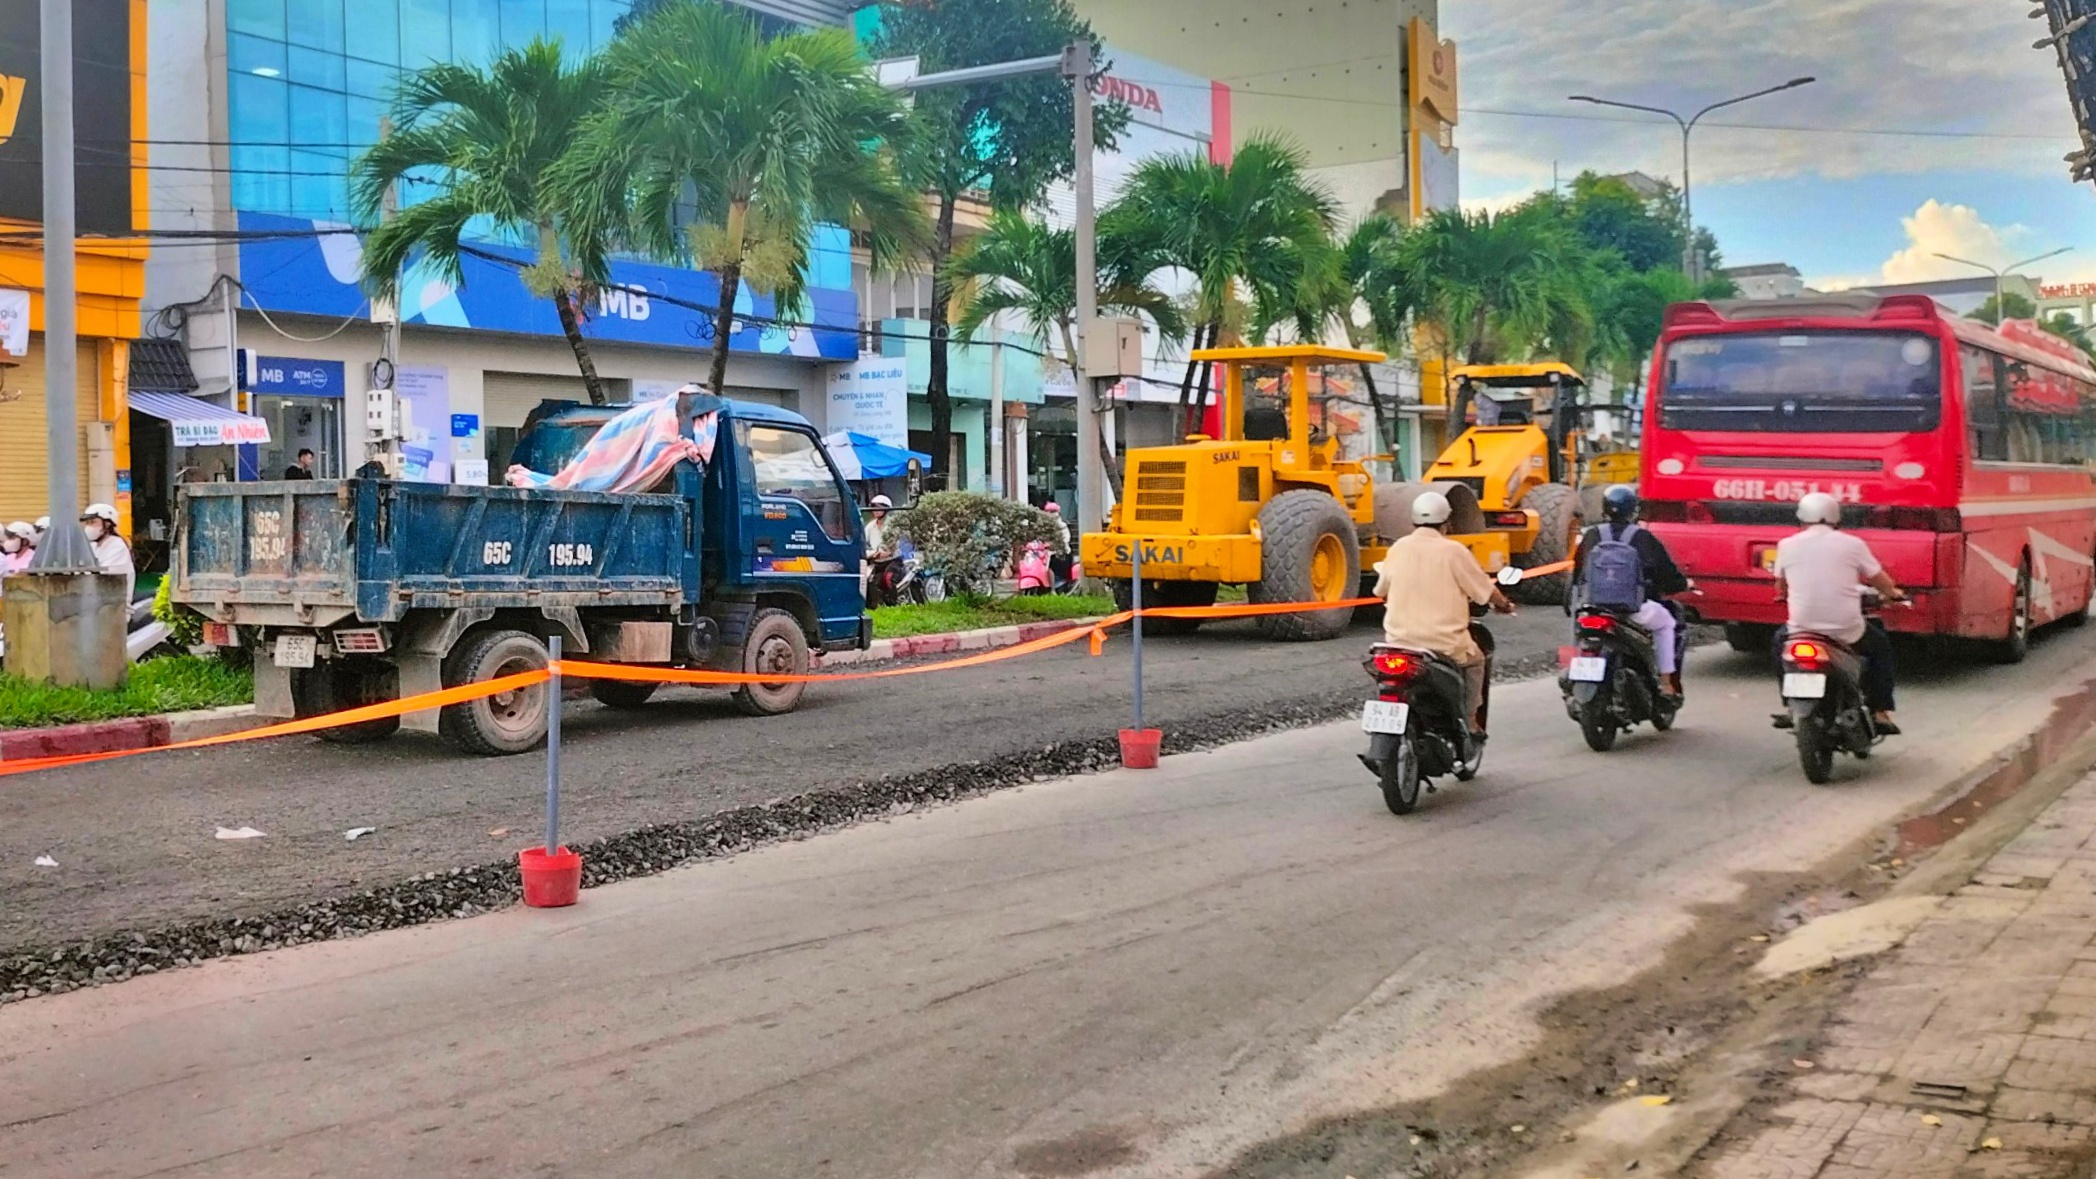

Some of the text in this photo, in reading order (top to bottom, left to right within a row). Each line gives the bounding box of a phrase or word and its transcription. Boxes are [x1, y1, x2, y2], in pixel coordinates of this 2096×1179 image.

[1093, 75, 1162, 114] ONDA
[600, 282, 651, 321] MB
[261, 368, 285, 383] MB
[293, 370, 311, 380] ATM
[839, 372, 851, 381] MB
[860, 371, 870, 380] MB
[1213, 451, 1240, 464] SAKAI
[1713, 479, 1862, 503] 66H-05144
[256, 511, 281, 535] 65C
[483, 541, 593, 566] 65C 195.94
[1114, 544, 1184, 564] SAKAI
